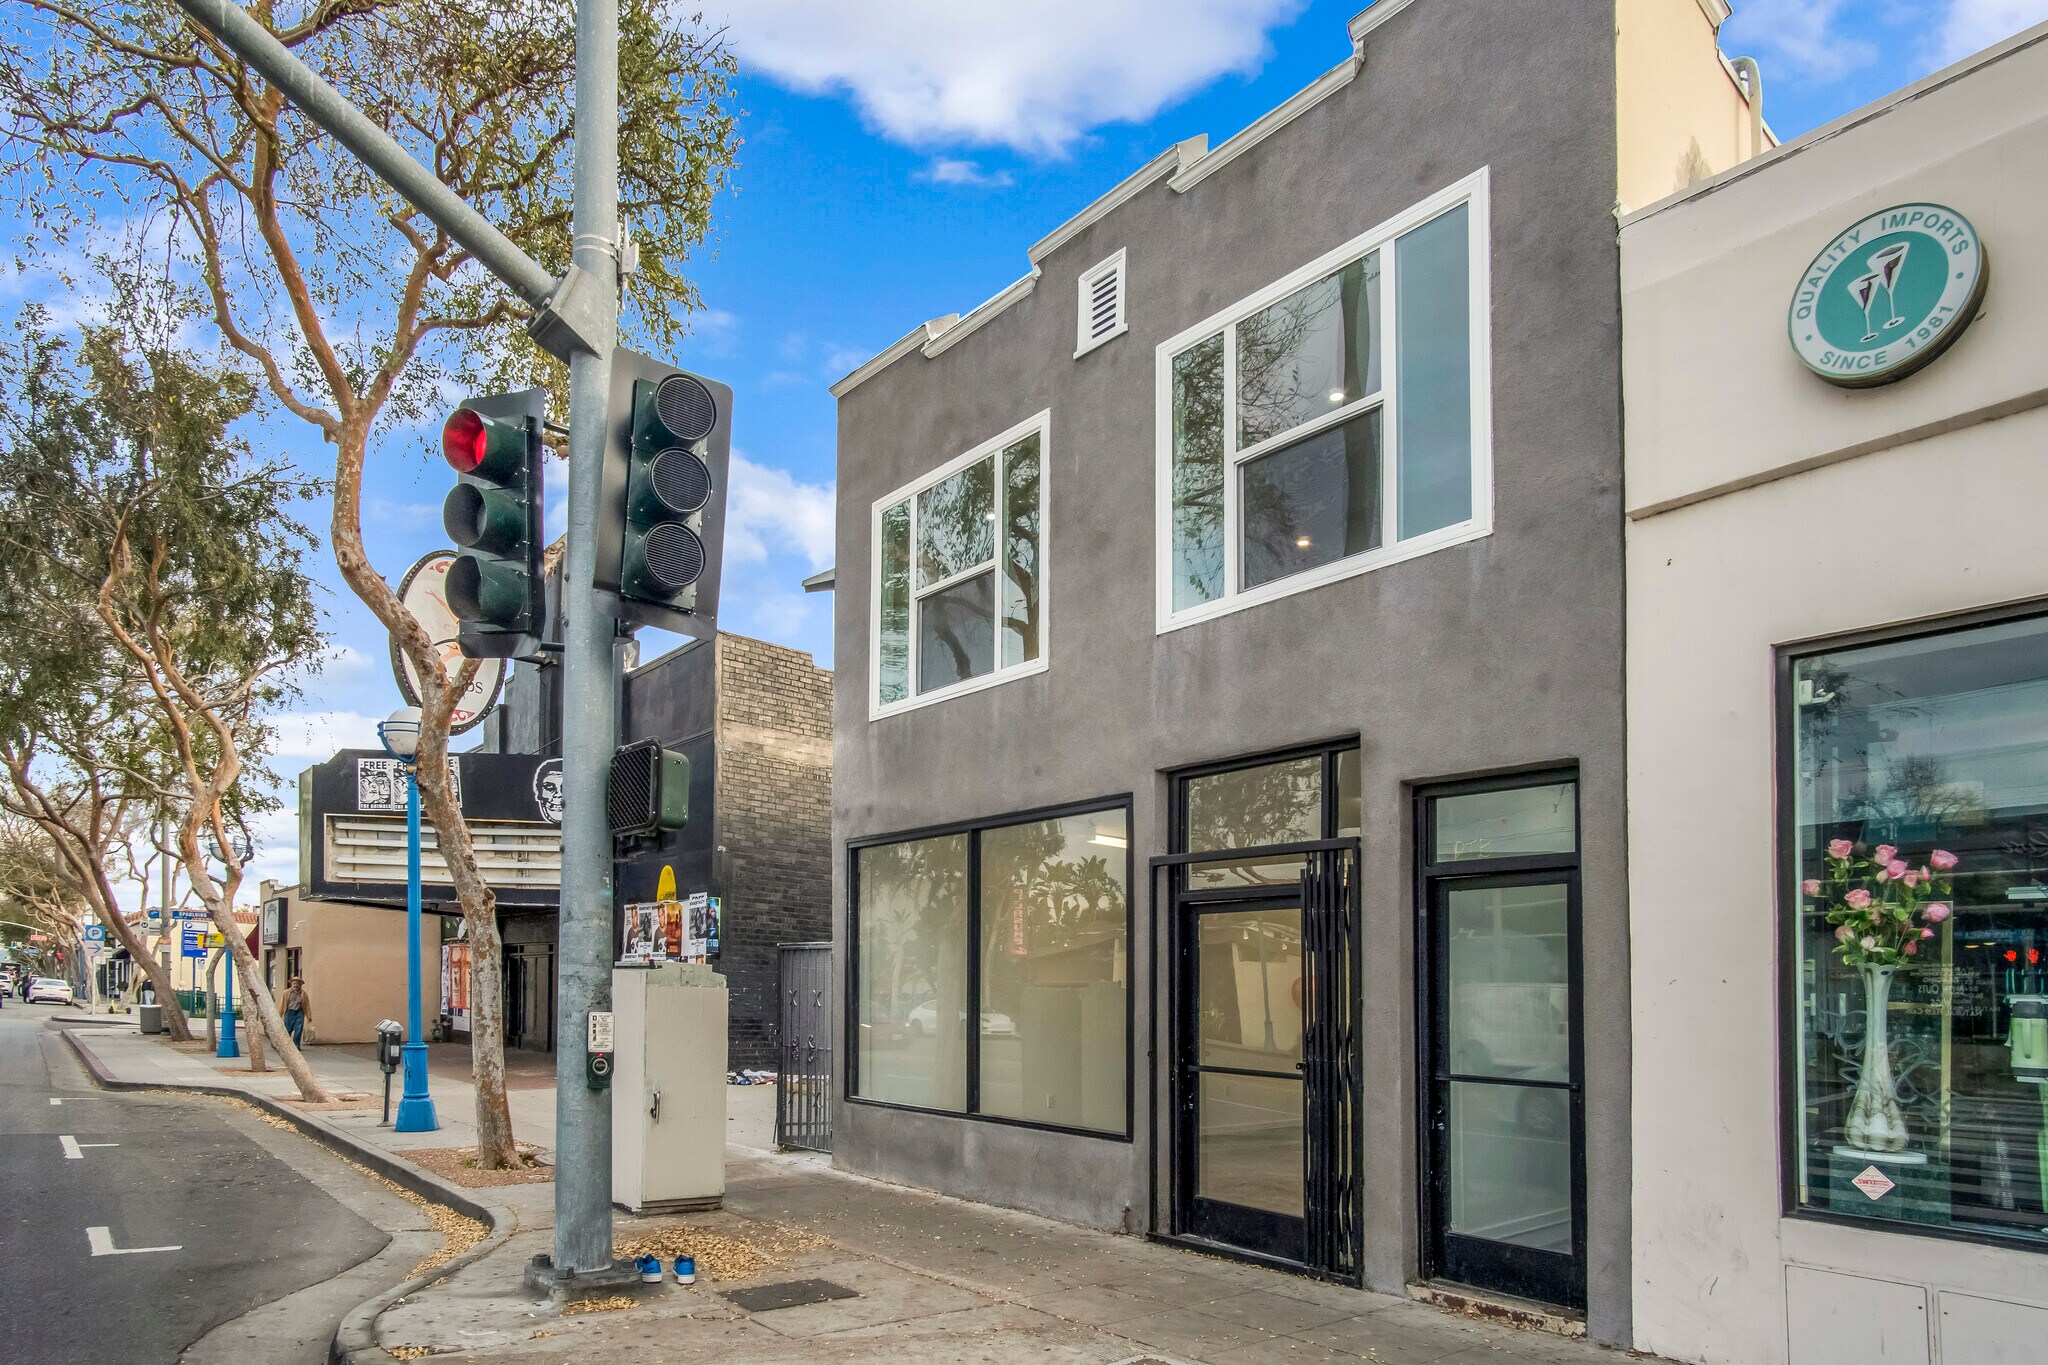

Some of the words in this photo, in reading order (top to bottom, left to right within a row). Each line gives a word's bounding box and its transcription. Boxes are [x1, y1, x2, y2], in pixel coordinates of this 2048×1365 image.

[1796, 229, 1862, 320] QUALITY
[1881, 211, 1969, 257] IMPORTS
[1819, 350, 1888, 370] SINCE
[1904, 306, 1954, 349] 1981
[363, 760, 388, 770] FREE
